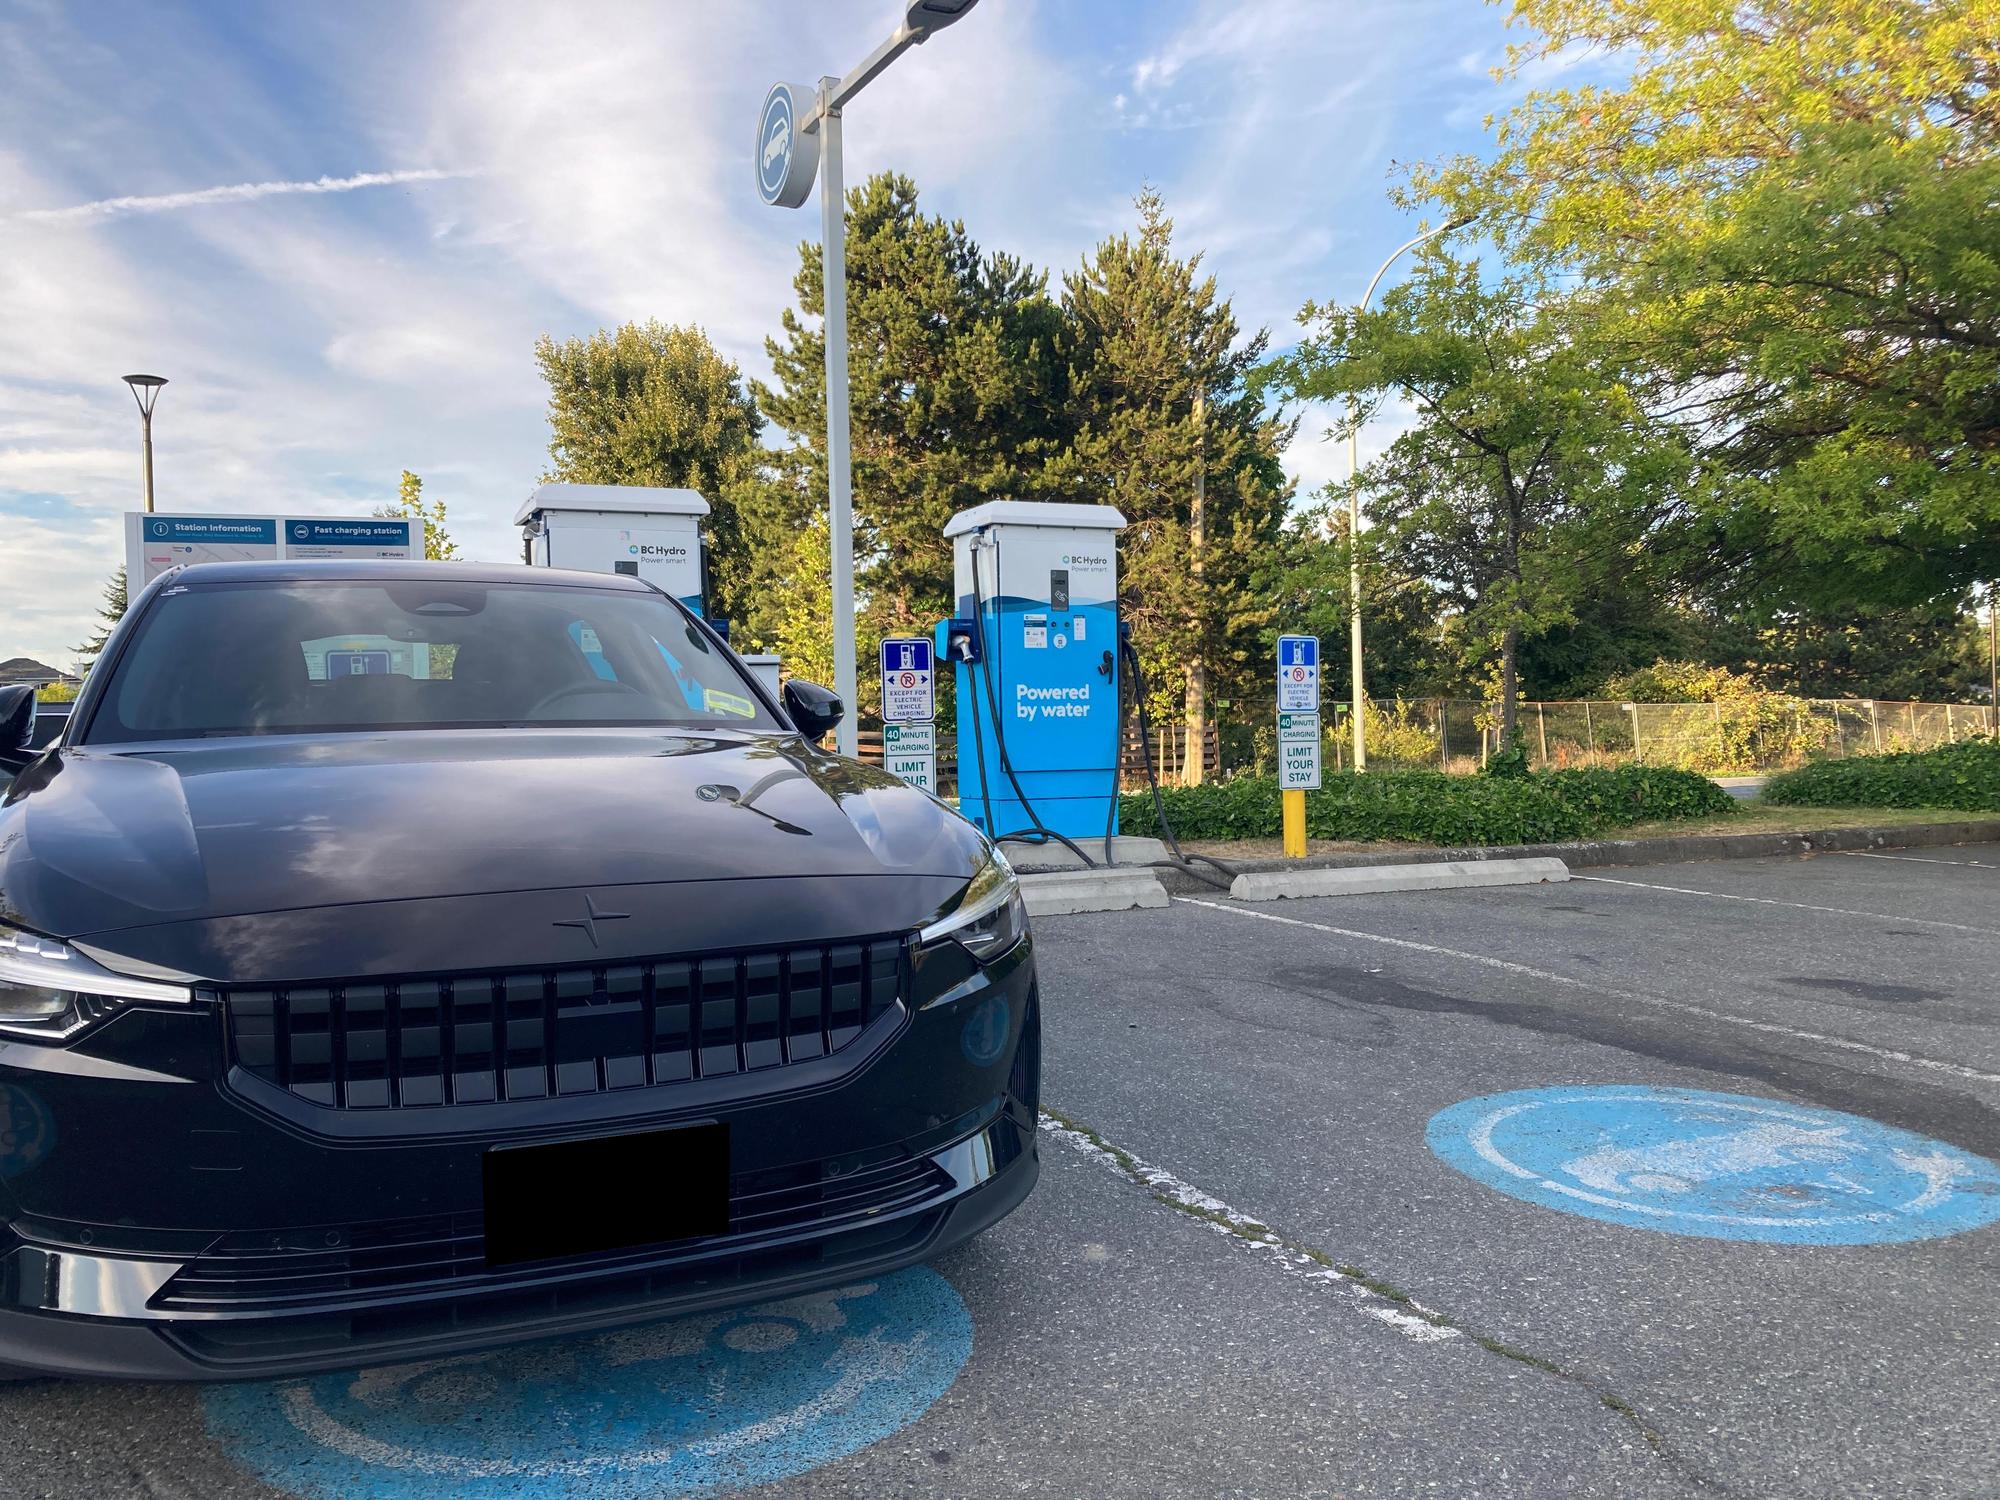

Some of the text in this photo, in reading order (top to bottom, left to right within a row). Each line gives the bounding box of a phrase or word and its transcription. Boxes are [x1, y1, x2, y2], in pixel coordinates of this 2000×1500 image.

[174, 523, 207, 532] Station
[314, 526, 402, 536] Fast charging station
[641, 545, 687, 557] BC Hydro
[1071, 556, 1108, 565] BC Hydro
[1016, 683, 1090, 700] Powered
[1016, 701, 1090, 722] by water
[1280, 718, 1291, 727] 40
[886, 730, 929, 740] 40 MINUTE
[889, 744, 930, 752] CHARGING
[1287, 747, 1313, 757] LIMIT
[895, 761, 926, 773] LIMIT
[1286, 759, 1314, 770] YOUR
[1288, 772, 1312, 783] STAY
